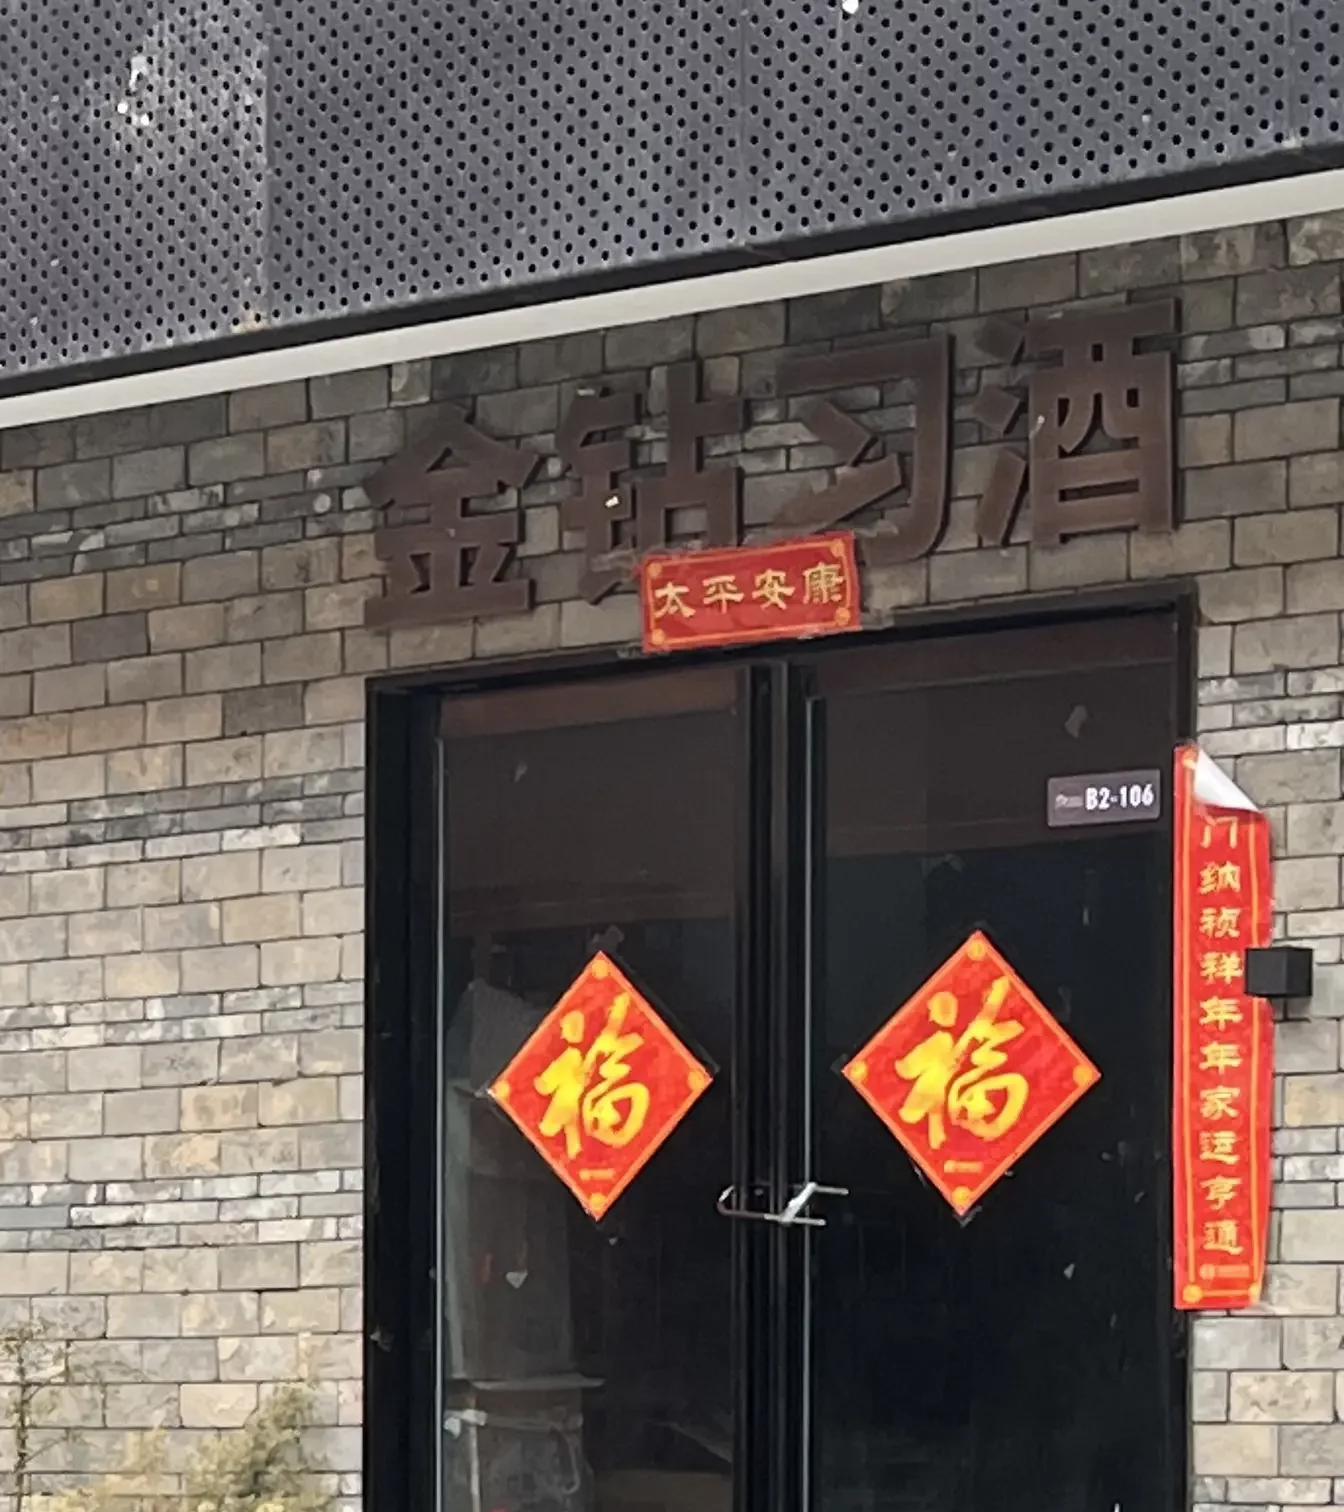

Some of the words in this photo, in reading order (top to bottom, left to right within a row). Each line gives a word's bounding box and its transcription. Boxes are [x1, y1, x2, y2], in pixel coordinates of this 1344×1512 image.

[364, 297, 1180, 630] 金钻习酒
[654, 561, 845, 619] 太平安康
[1085, 783, 1154, 811] B2-106
[533, 991, 650, 1160] 福
[895, 974, 1030, 1150] 福
